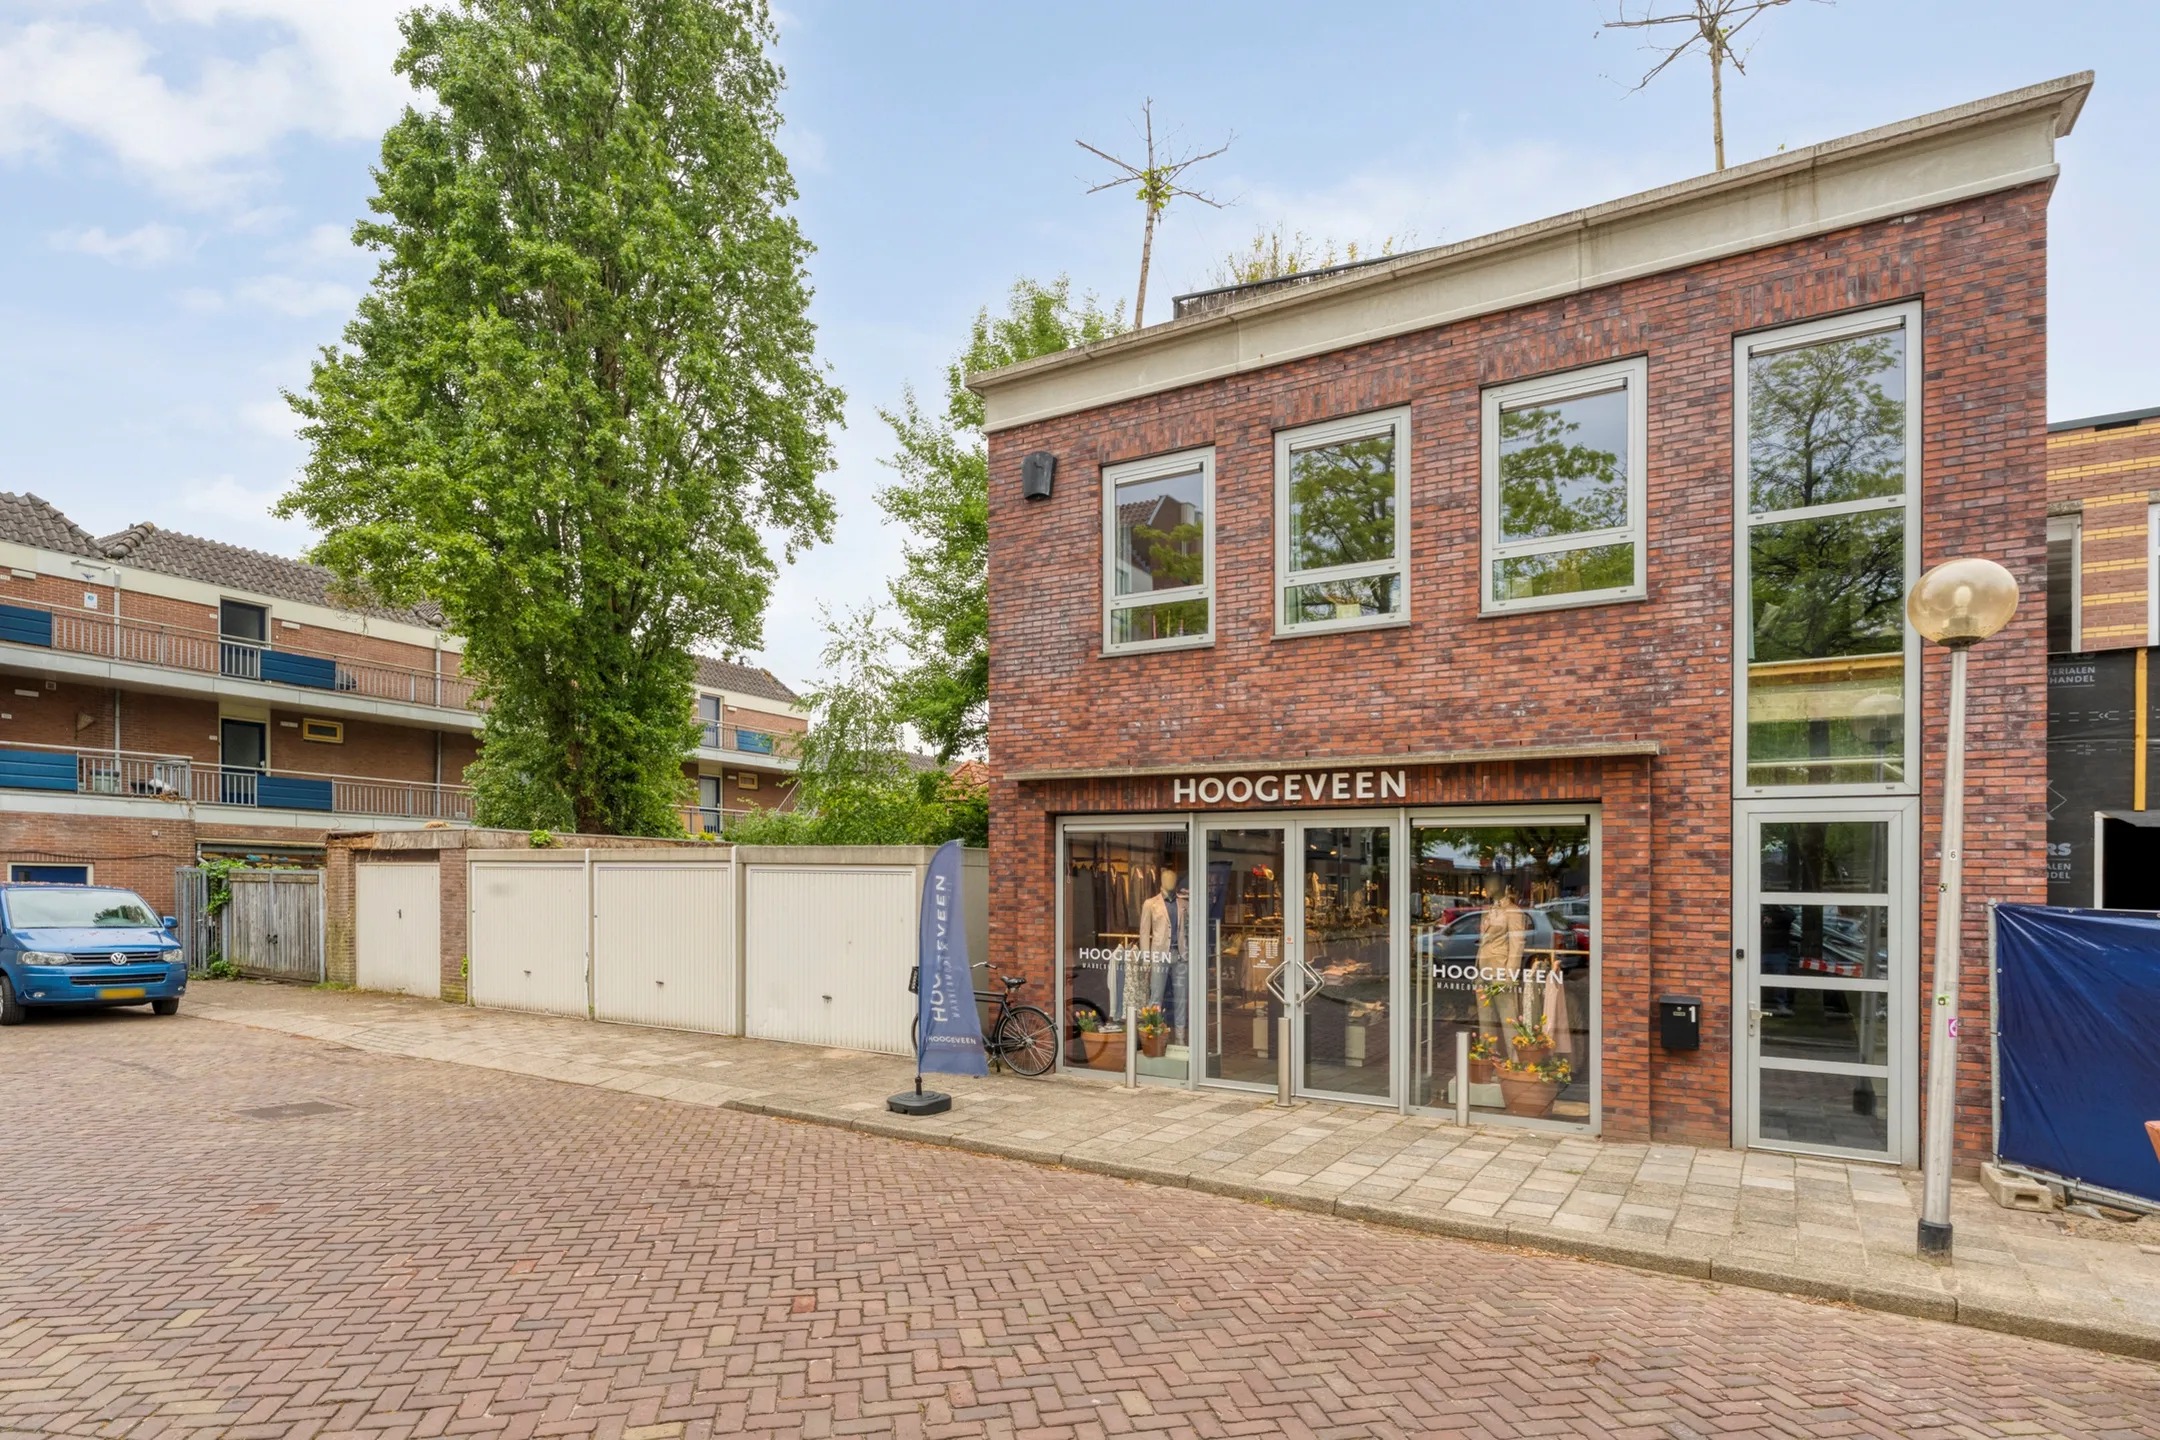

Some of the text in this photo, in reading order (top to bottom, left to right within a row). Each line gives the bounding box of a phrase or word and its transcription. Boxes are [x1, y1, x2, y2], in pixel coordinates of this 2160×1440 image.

[2050, 675, 2095, 683] HANDEL
[1173, 770, 1406, 803] HOOGEVEEN
[1950, 851, 1957, 859] 6
[1079, 947, 1172, 964] HOOGEVEEN
[1432, 964, 1564, 985] HOOGEVEEN
[1688, 1005, 1696, 1023] 1
[928, 1035, 977, 1045] HOOGEVEEN
